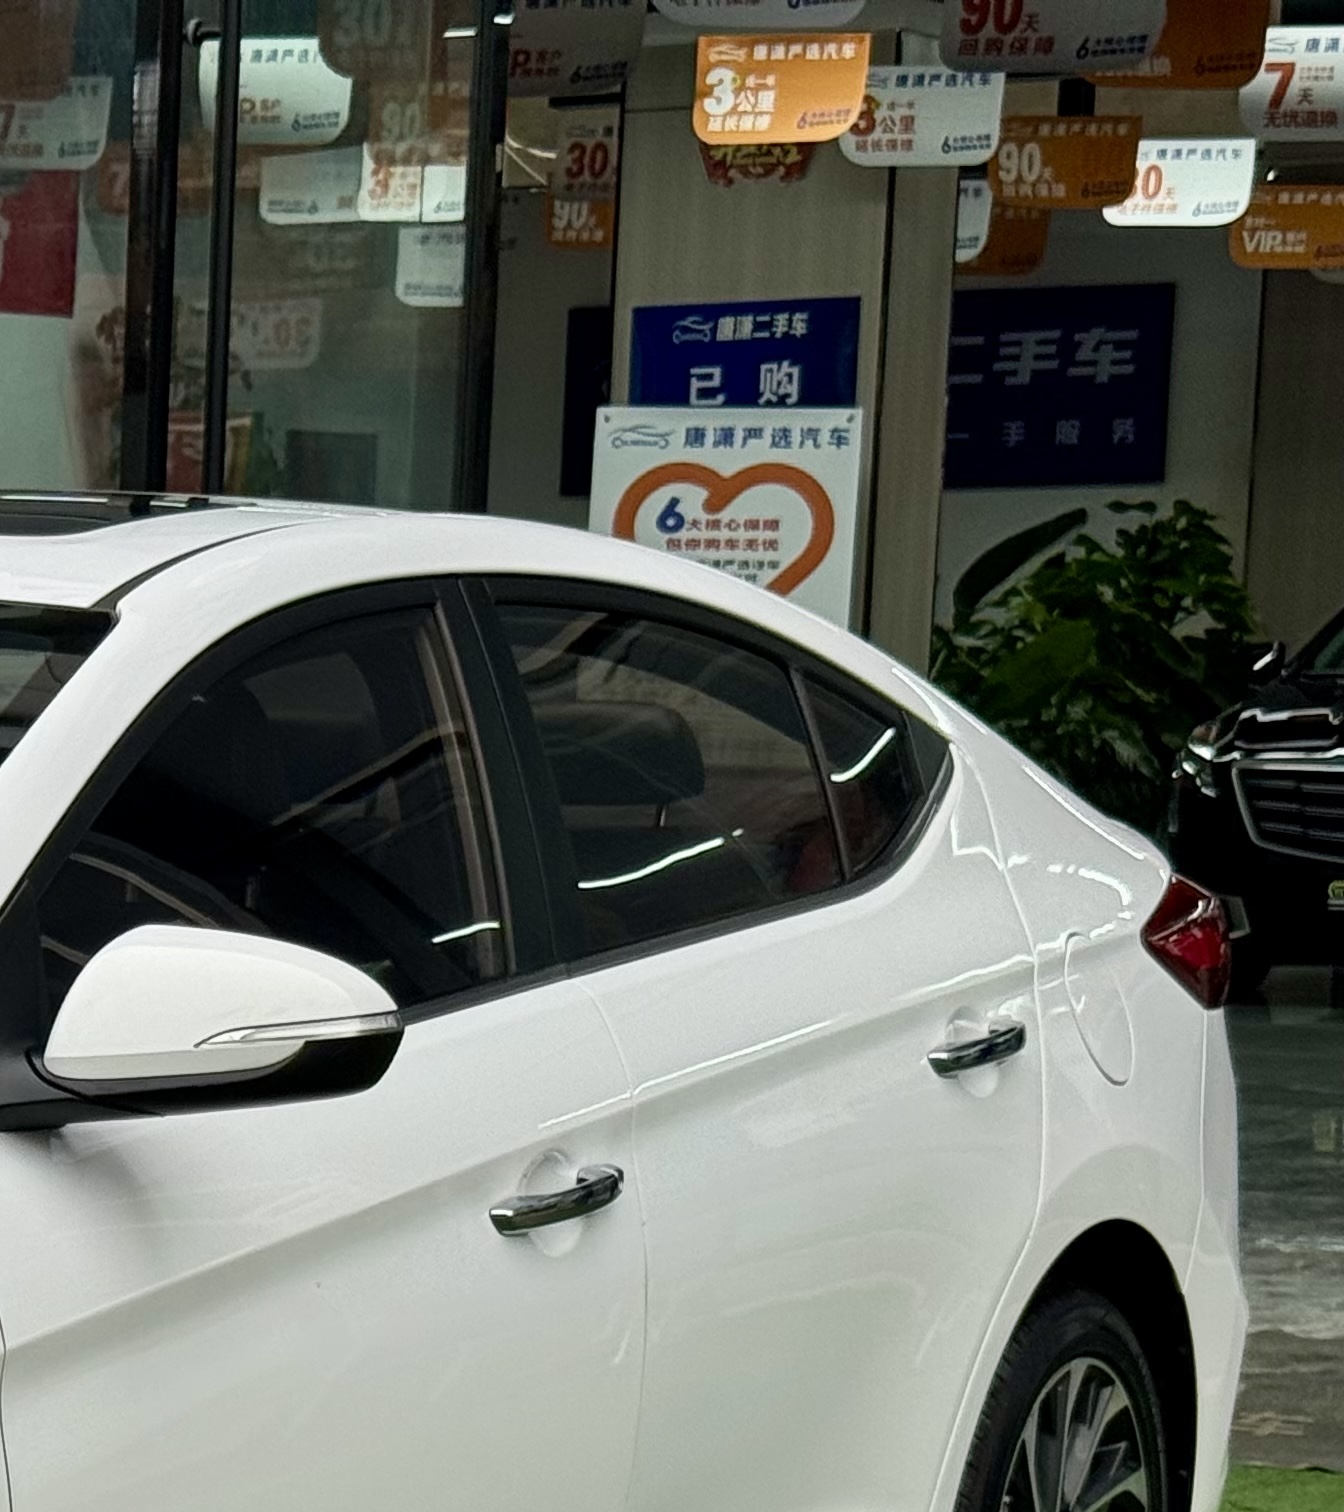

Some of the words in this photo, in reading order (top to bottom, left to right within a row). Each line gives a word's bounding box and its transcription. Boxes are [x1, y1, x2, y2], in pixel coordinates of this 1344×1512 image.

[715, 312, 809, 342] 唐潇二手车
[683, 425, 850, 450] 唐潇严选汽车
